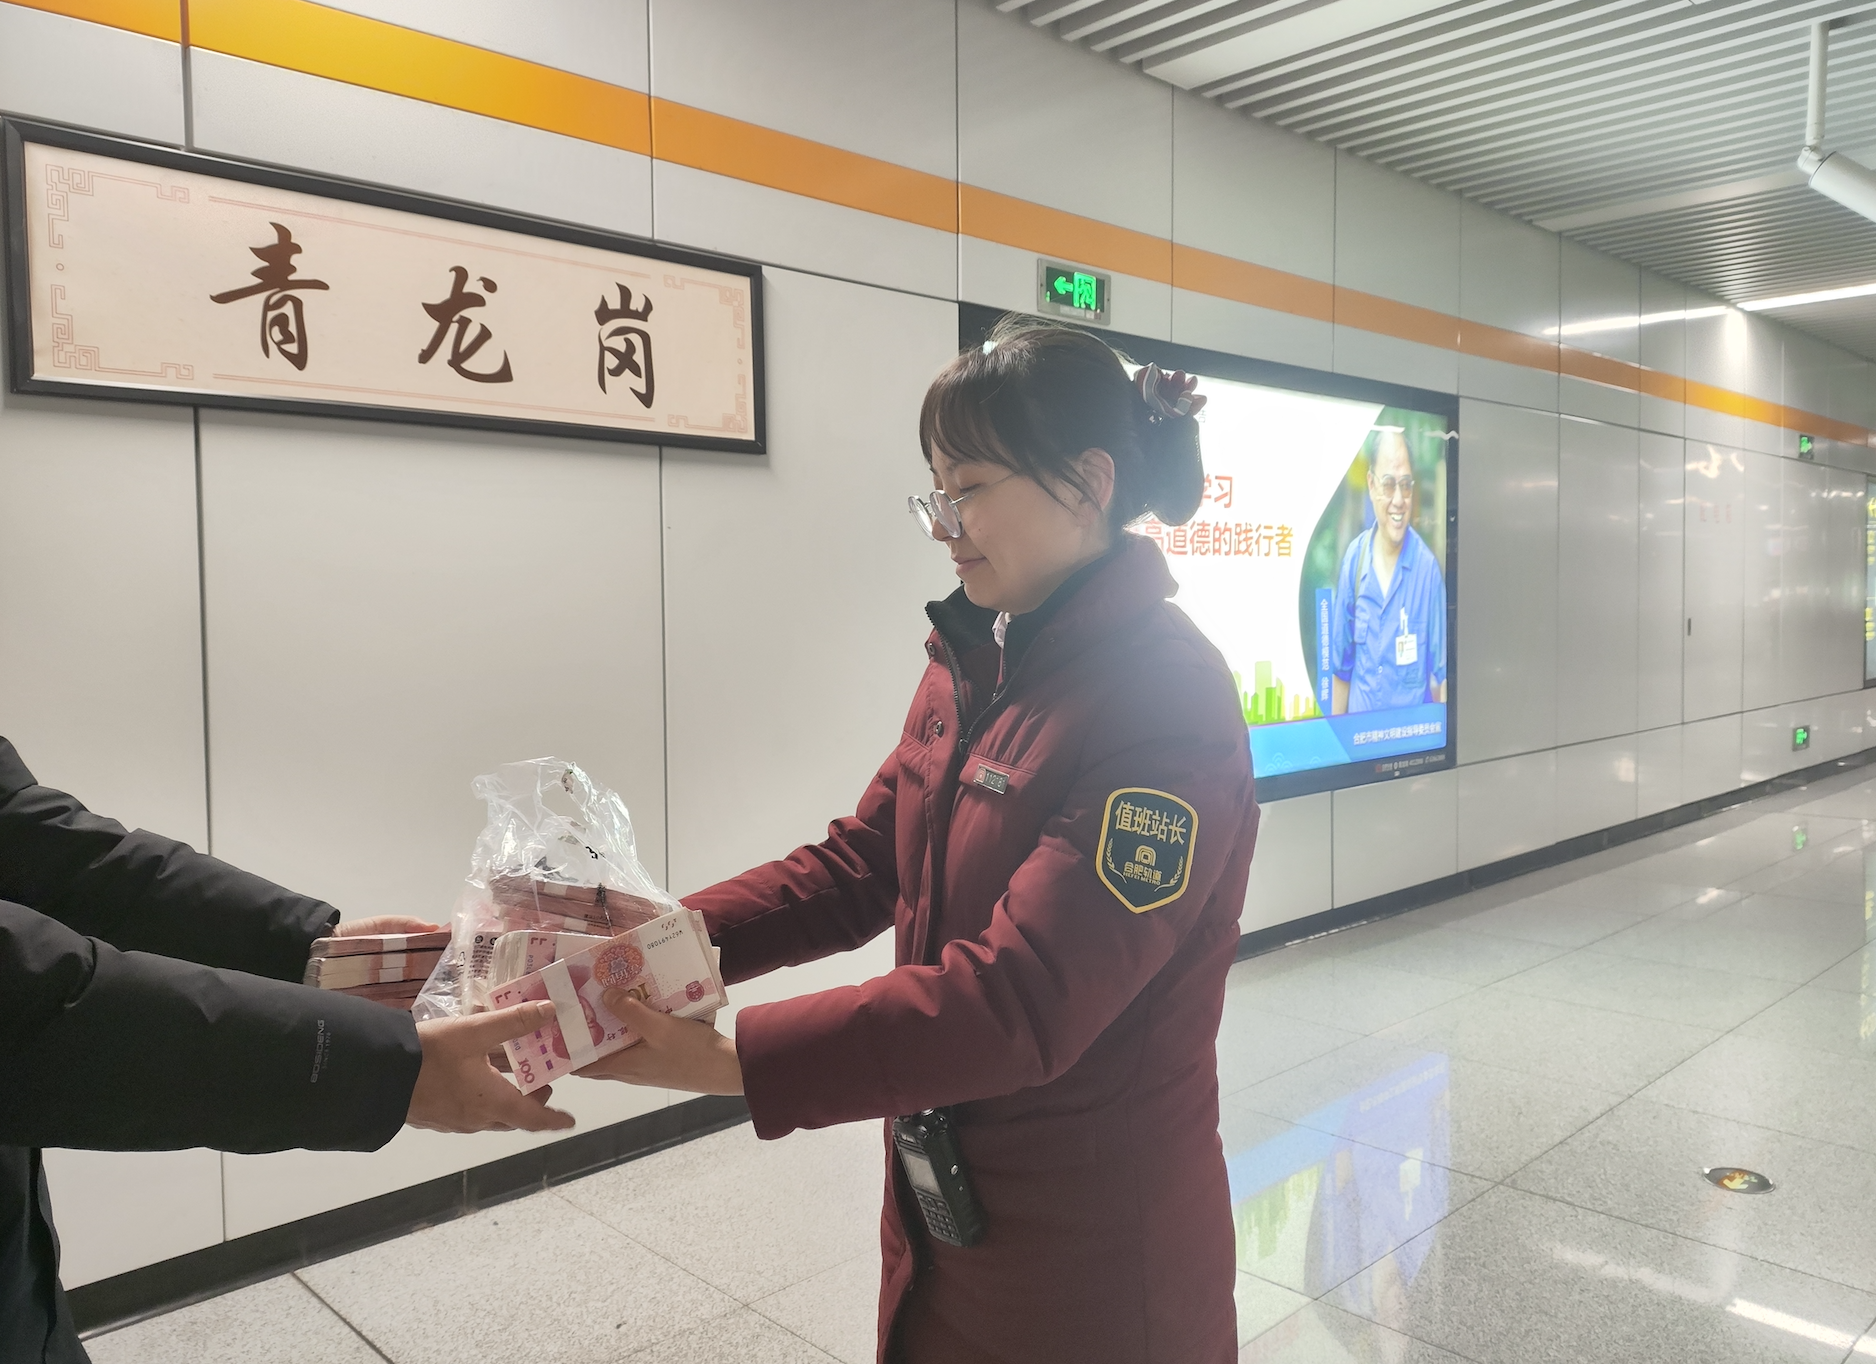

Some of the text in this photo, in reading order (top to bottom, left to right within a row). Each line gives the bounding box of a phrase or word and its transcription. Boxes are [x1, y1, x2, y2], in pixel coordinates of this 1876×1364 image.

[209, 221, 656, 409] 青龙岗
[1115, 800, 1187, 845] 值班站长
[1124, 861, 1162, 881] 合肥轨道
[310, 1019, 325, 1083] BOSIDENG
[517, 1057, 536, 1084] 100
